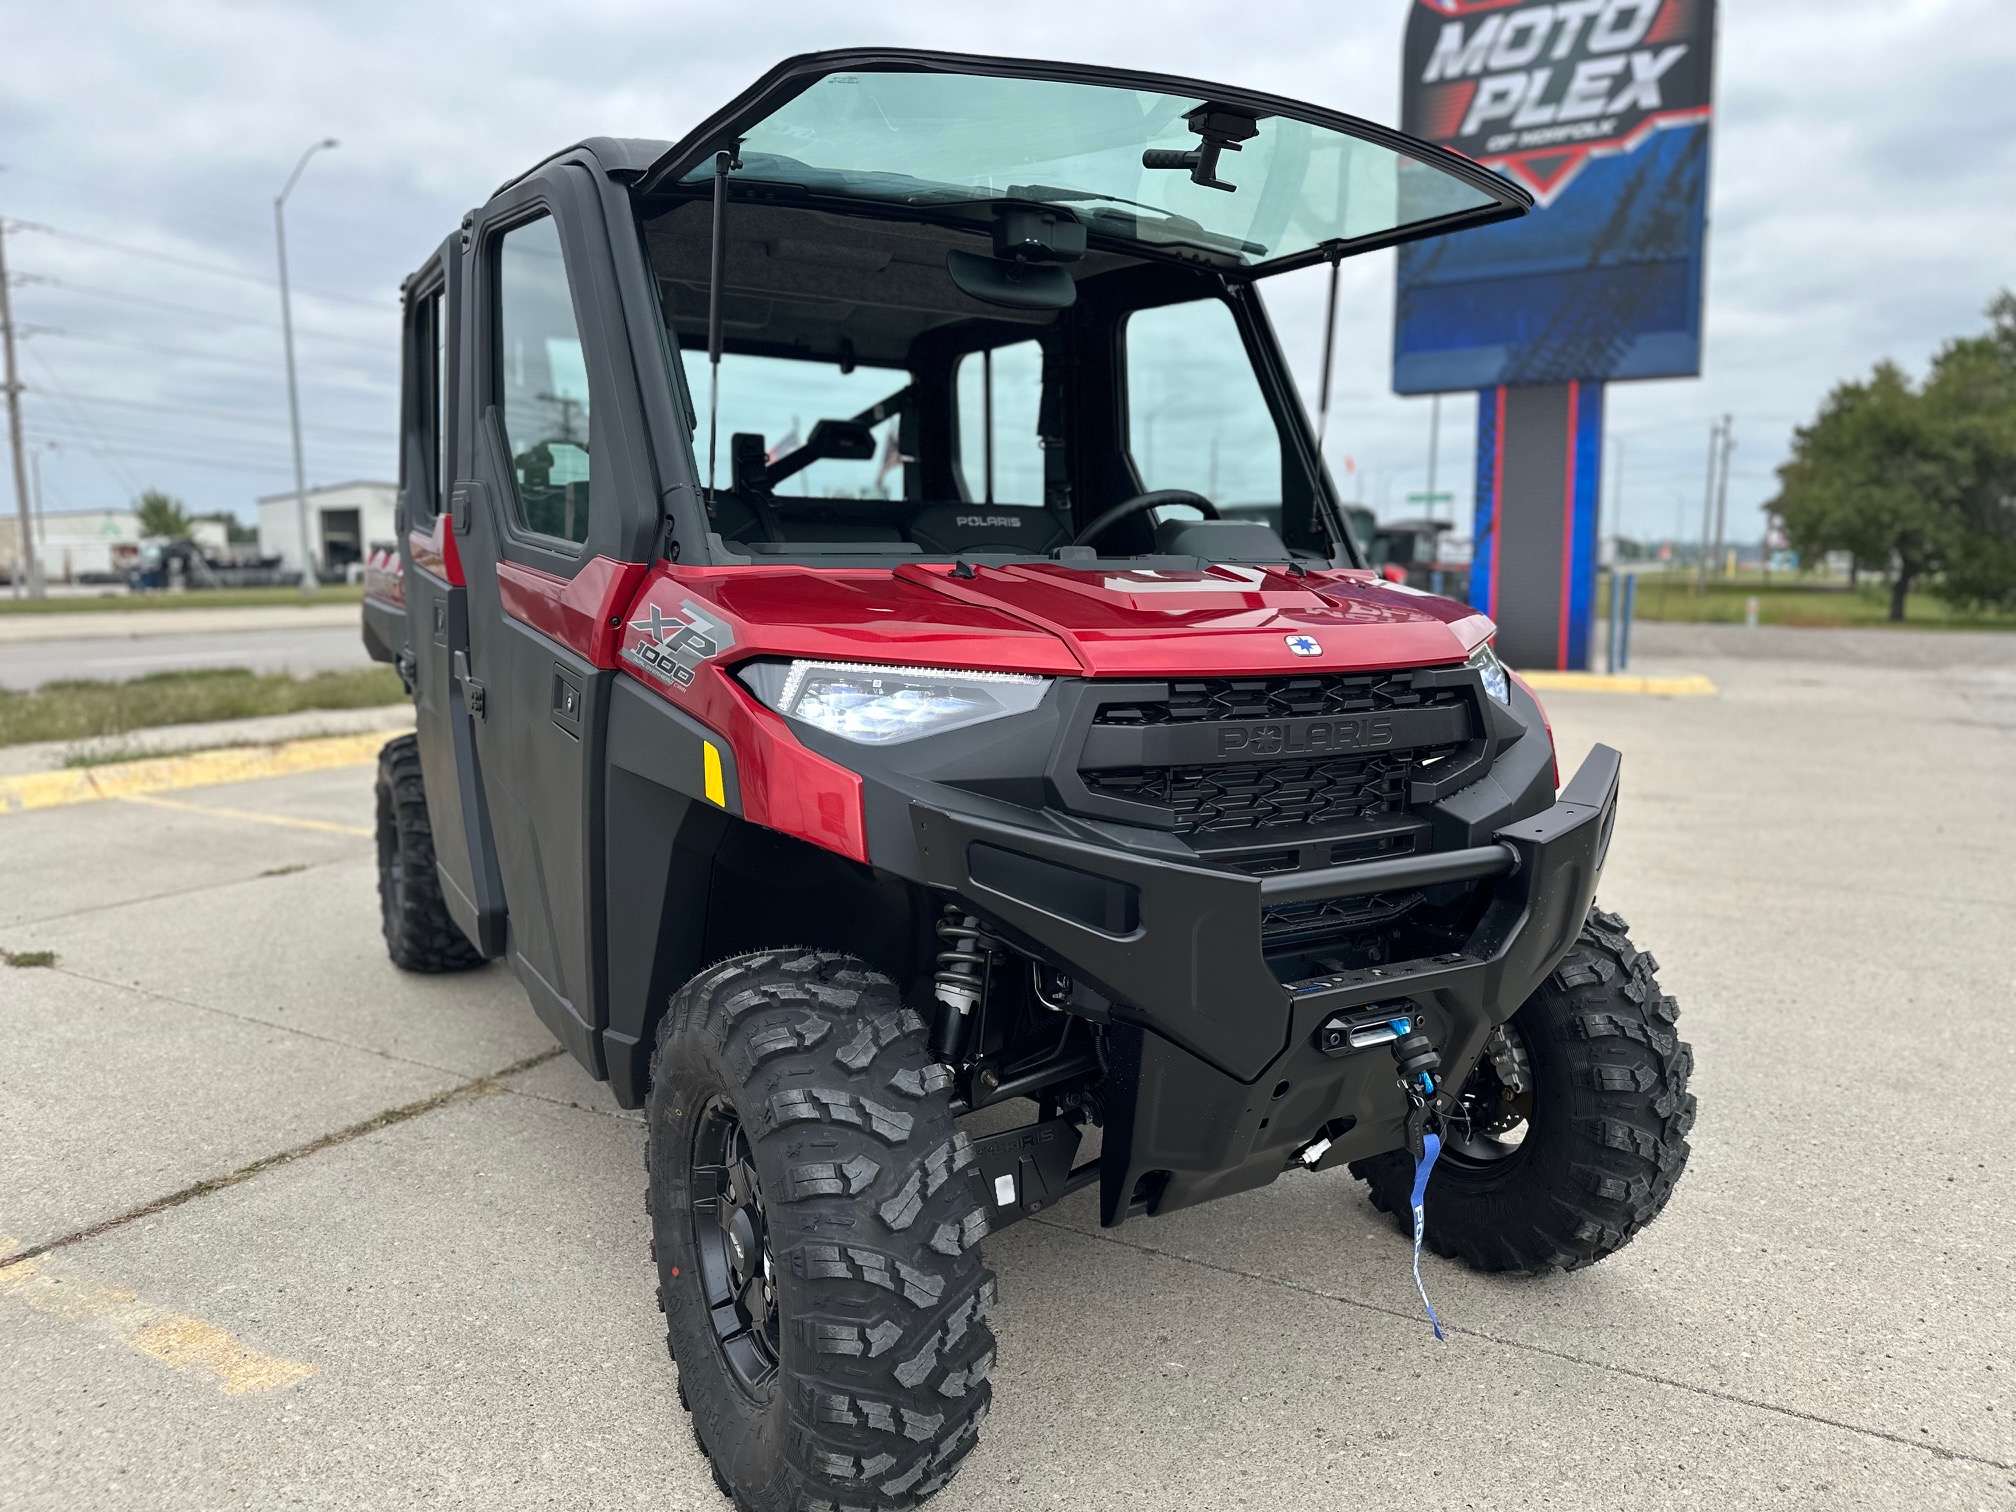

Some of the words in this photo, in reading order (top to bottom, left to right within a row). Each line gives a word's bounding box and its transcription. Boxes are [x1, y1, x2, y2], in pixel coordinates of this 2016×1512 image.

[1421, 0, 1661, 82] MOTO
[1459, 44, 1690, 136] PLEX
[956, 516, 1021, 527] POLARIS
[627, 602, 717, 659] XP
[630, 640, 695, 687] 1000
[673, 682, 687, 693] CAM
[1217, 717, 1393, 758] POLARIS
